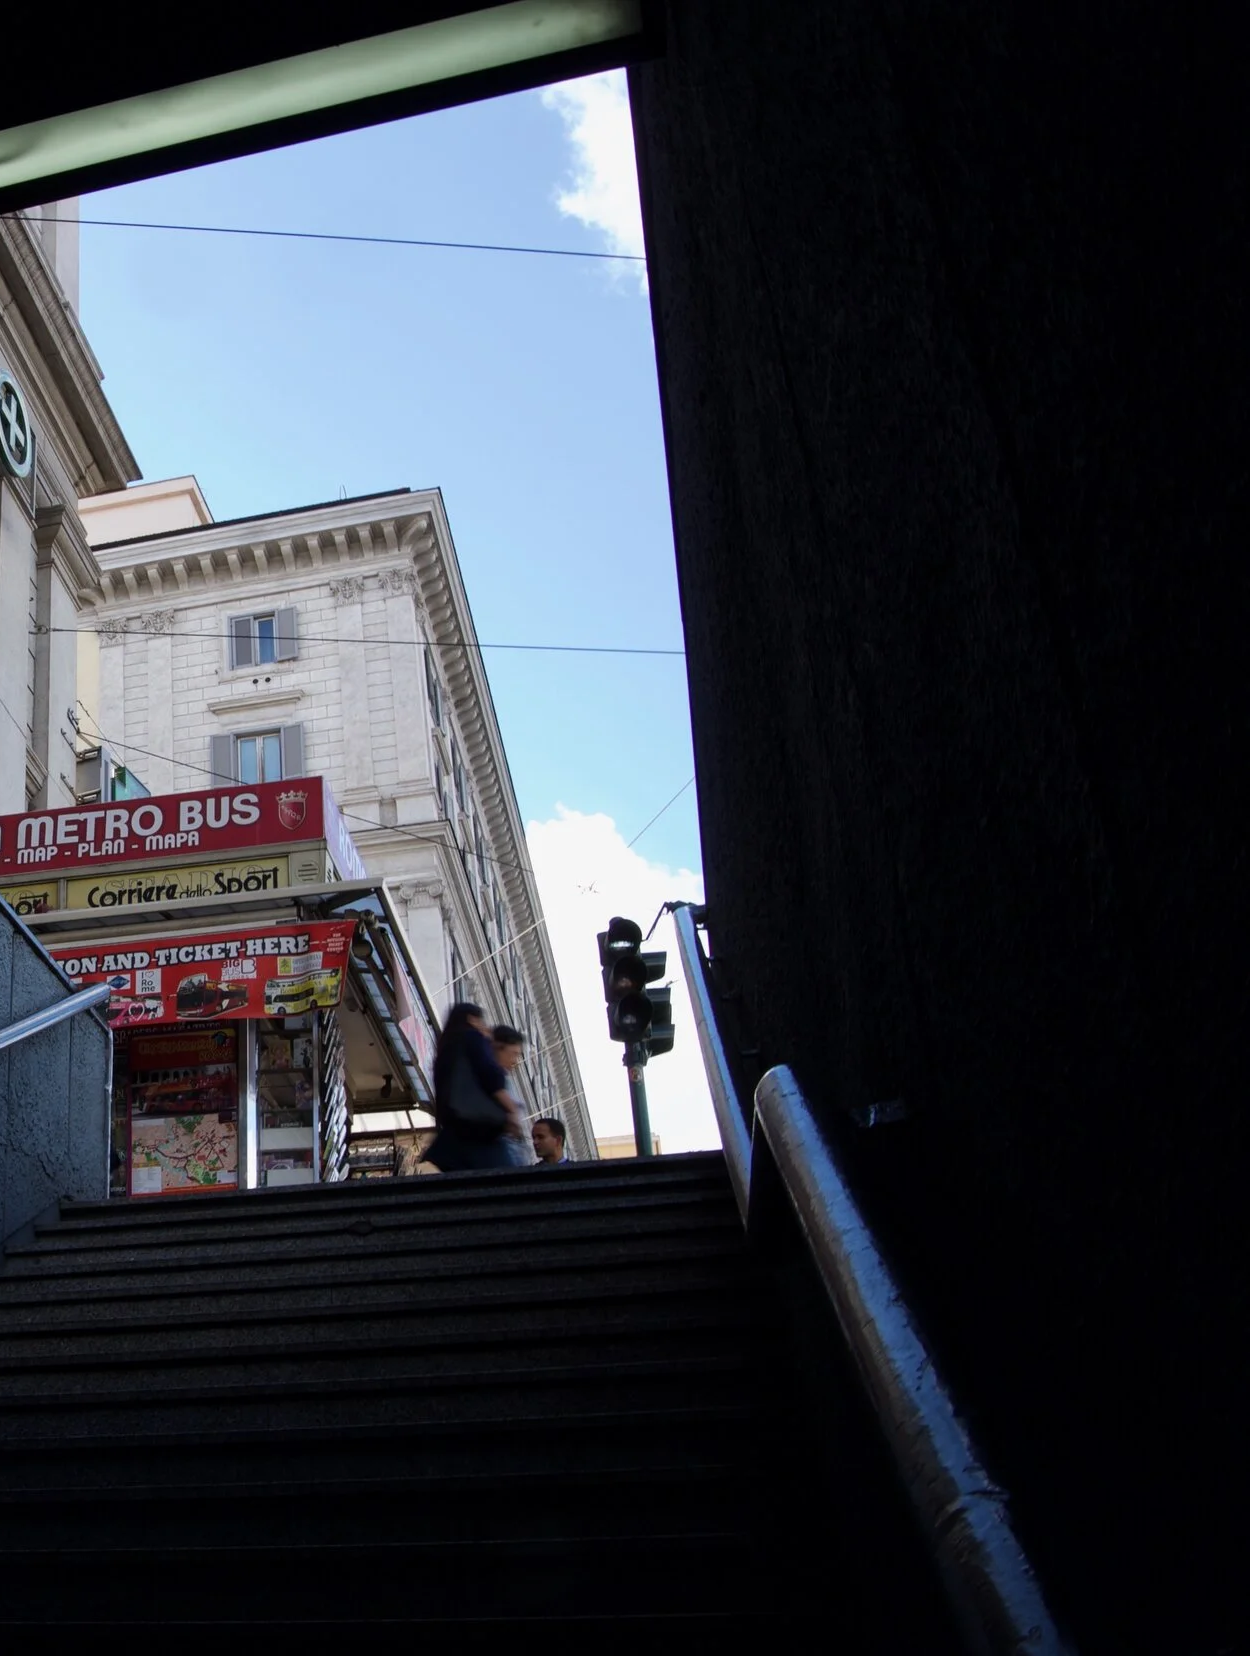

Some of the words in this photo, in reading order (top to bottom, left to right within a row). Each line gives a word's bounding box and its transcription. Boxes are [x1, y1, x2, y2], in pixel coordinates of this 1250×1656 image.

[17, 805, 163, 849] METRO
[180, 793, 260, 832] BUS
[17, 846, 59, 865] MAP
[77, 839, 125, 858] PLAN
[145, 831, 200, 851] MAPA
[87, 881, 178, 908] Corriere
[101, 951, 150, 972] AND
[154, 940, 241, 966] TICKET
[245, 934, 310, 956] HERE
